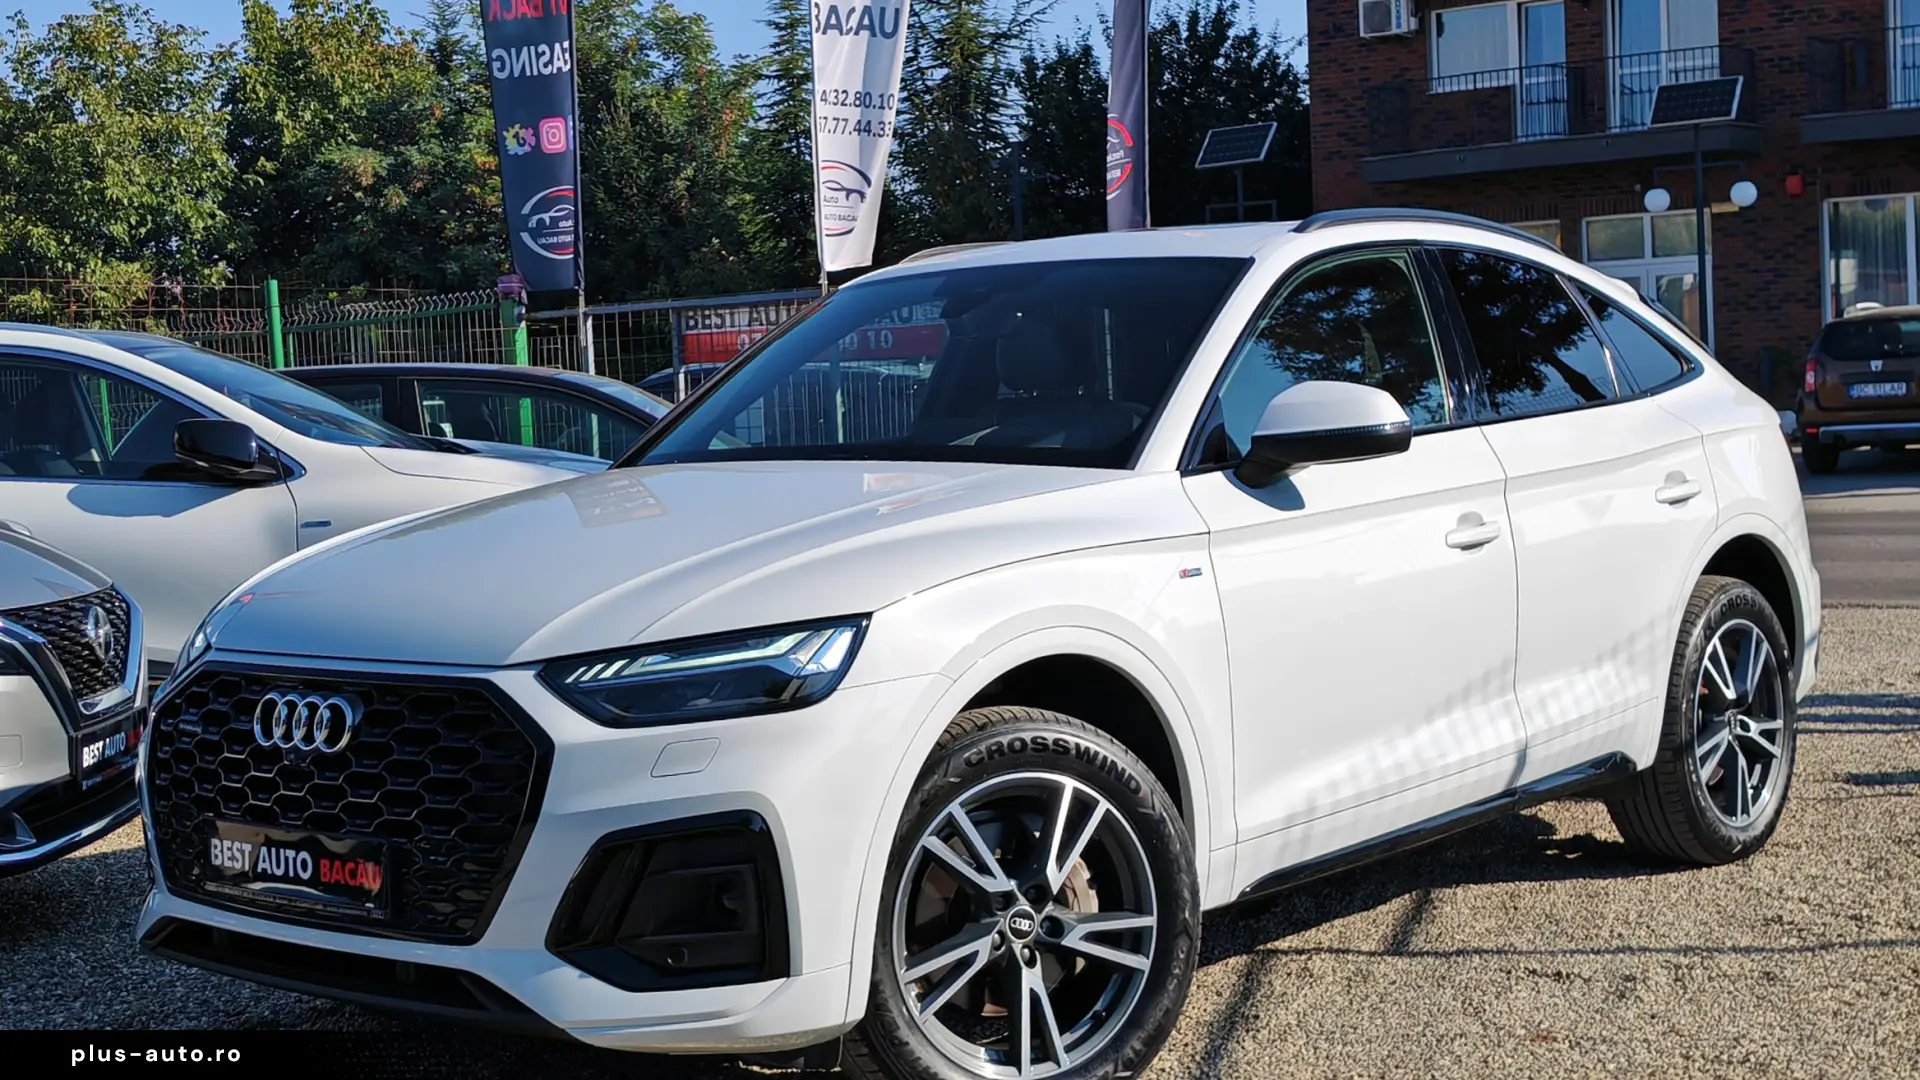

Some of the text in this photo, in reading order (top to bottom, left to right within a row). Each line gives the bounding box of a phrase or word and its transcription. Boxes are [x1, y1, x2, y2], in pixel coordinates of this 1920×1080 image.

[83, 740, 104, 768] BEST
[104, 731, 126, 758] AUTO
[962, 735, 1142, 796] CROSSWIND
[210, 838, 252, 872] BEST
[257, 846, 313, 880] AUTO
